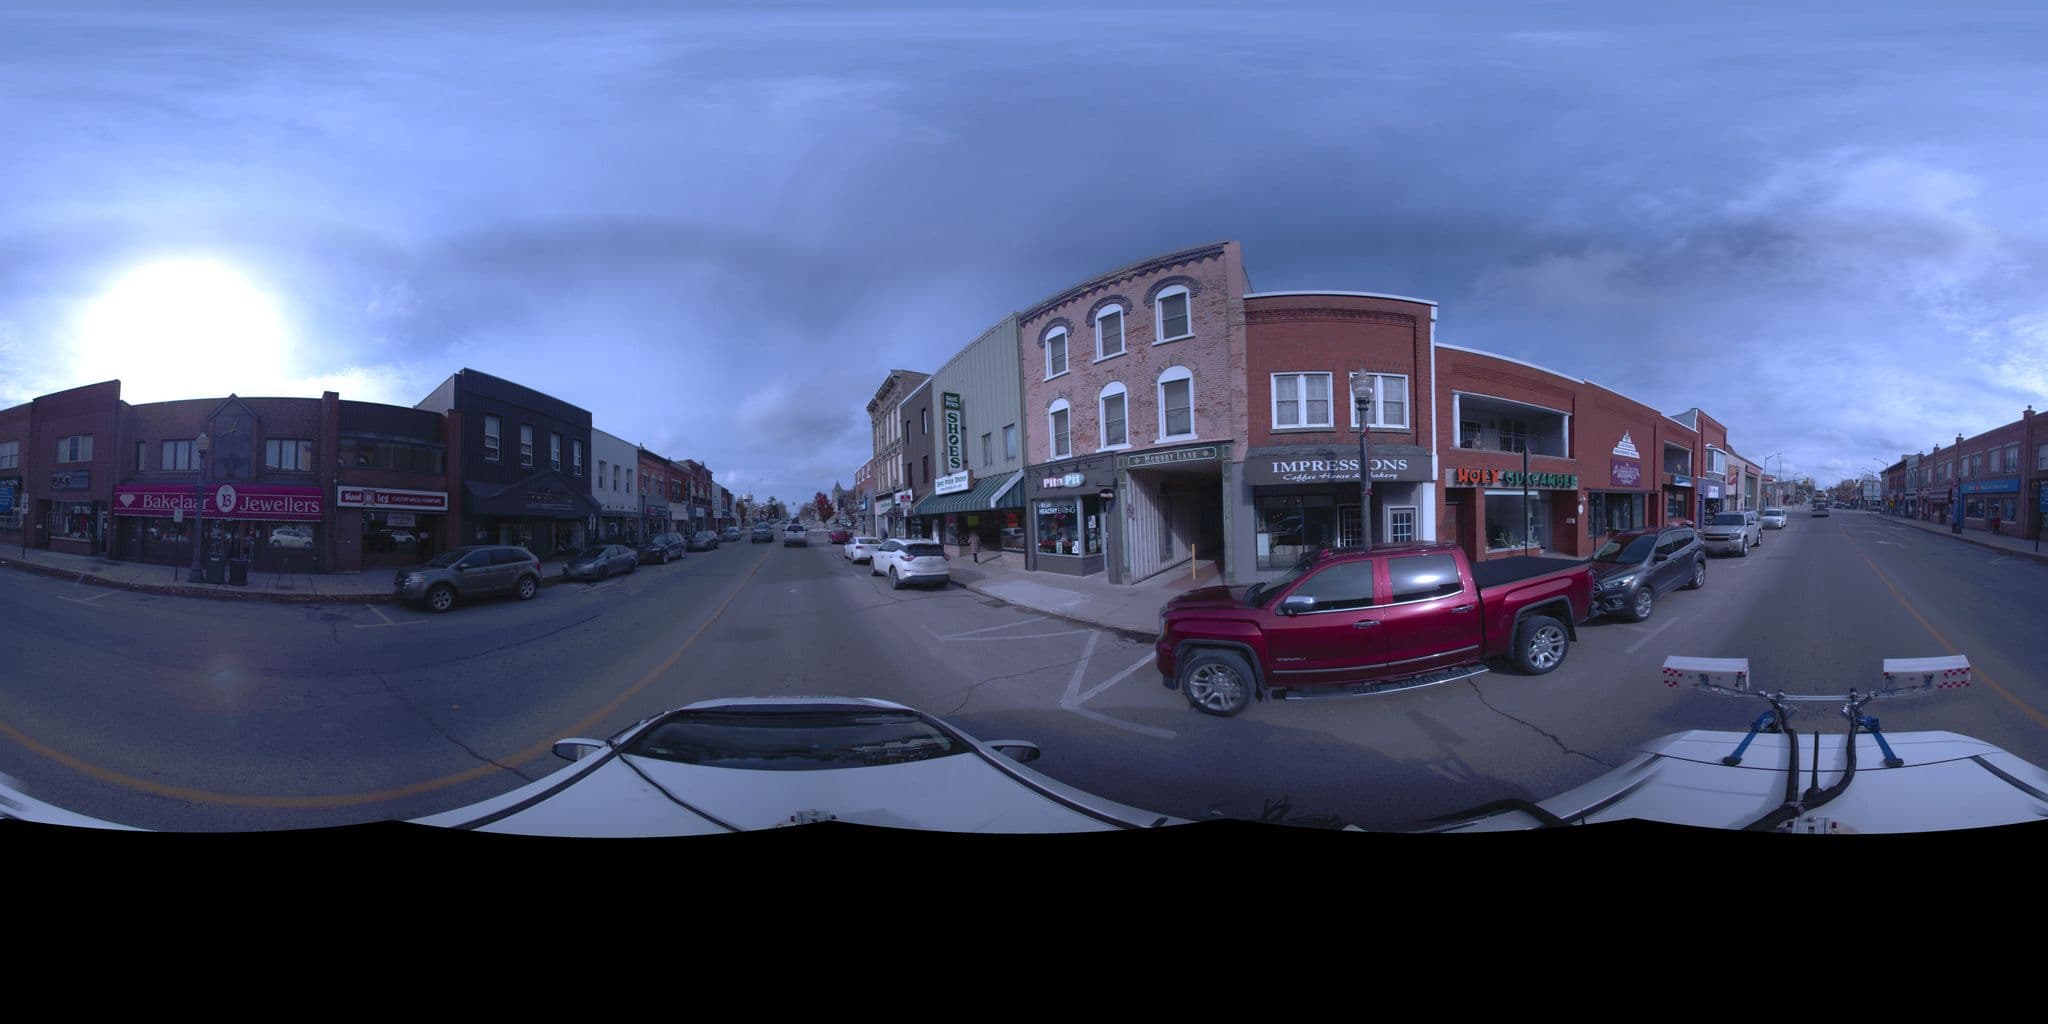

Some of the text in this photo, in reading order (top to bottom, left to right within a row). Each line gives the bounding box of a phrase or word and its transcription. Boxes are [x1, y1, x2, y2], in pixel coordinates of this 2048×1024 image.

[947, 412, 961, 469] SHOES
[1271, 458, 1408, 473] IMPRESSONS
[1043, 474, 1081, 488] Pita Pit
[1283, 473, 1317, 483] Coffee
[1456, 467, 1499, 484] HOLY
[143, 494, 209, 510] Bakelaar
[239, 496, 320, 513] Jewellers
